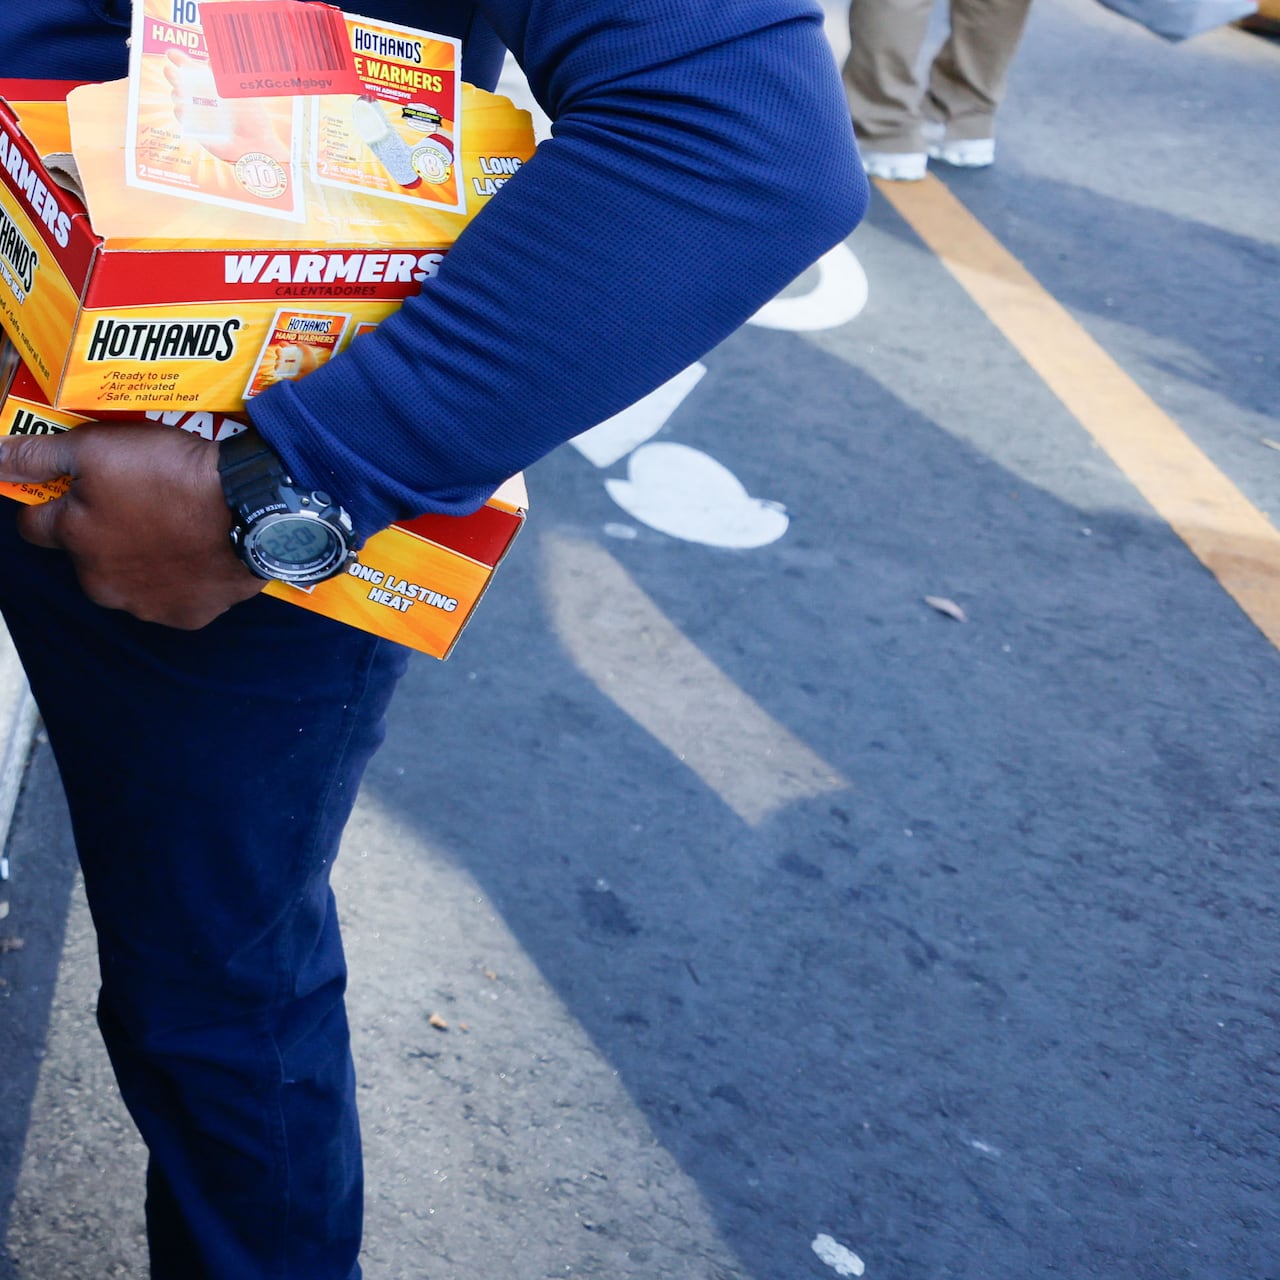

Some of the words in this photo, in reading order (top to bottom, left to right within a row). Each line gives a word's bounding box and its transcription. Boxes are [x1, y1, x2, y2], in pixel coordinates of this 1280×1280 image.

[152, 24, 200, 49] HAND
[355, 28, 422, 64] HOTHANDS
[354, 57, 363, 74] E
[366, 60, 442, 93] WARMERS
[224, 254, 444, 283] WARMERS
[275, 286, 376, 296] CALENTADORES
[275, 332, 297, 341] HAND
[298, 333, 335, 344] WARMERS
[288, 318, 332, 333] HOTHANDS
[87, 319, 240, 362] HOTHANDS
[109, 382, 125, 391] Air
[128, 382, 176, 391] activated
[112, 371, 145, 381] Ready
[148, 372, 158, 380] to
[106, 392, 132, 401] Safe,
[135, 393, 173, 401] natural
[176, 393, 199, 401] heat
[348, 563, 384, 585] ONG
[384, 575, 458, 613] LASTING
[367, 587, 414, 613] HEAT
